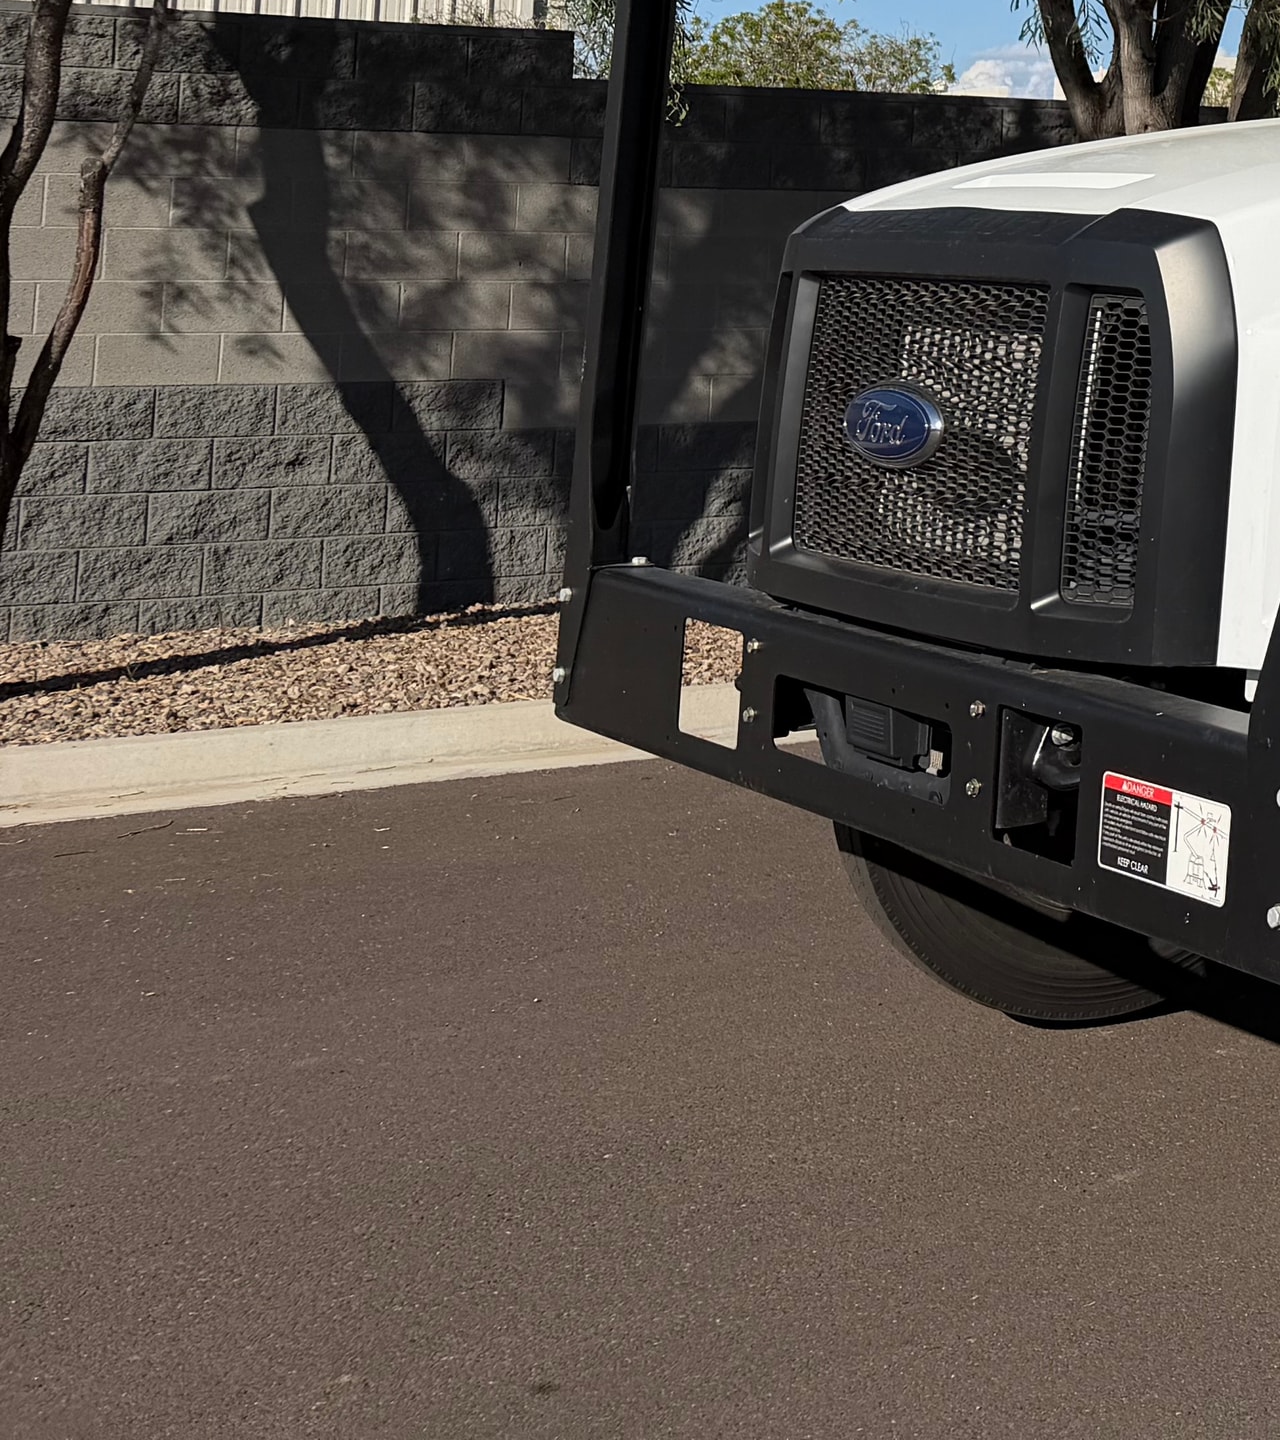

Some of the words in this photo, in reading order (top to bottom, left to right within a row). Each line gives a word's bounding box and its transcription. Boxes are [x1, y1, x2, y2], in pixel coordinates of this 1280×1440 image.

[856, 399, 909, 445] Ford
[1127, 781, 1154, 798] DANGER
[1131, 861, 1148, 874] CLEAR
